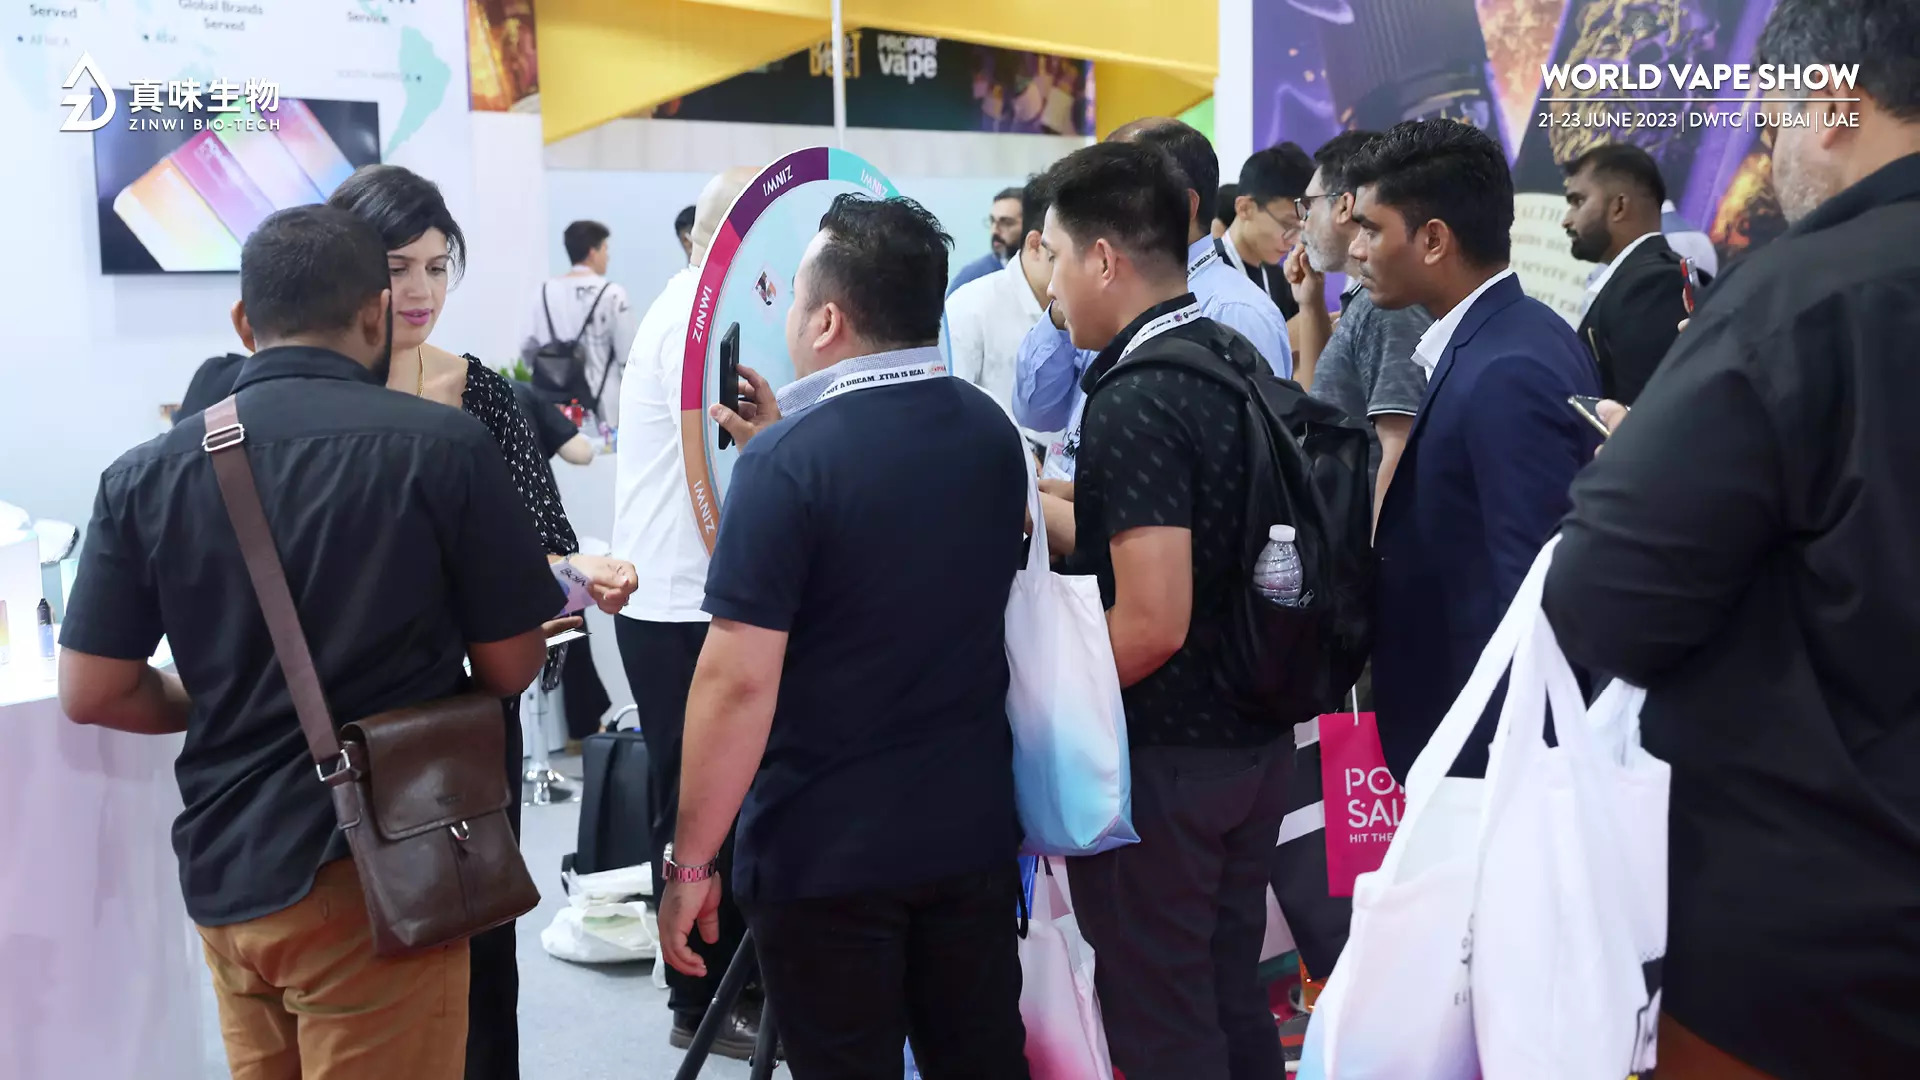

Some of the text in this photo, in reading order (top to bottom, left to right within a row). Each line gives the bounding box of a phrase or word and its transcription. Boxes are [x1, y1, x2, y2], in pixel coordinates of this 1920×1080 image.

[29, 4, 78, 19] Served
[222, 1, 264, 15] Brands
[203, 18, 246, 32] Served
[877, 33, 938, 54] PROPER
[878, 53, 938, 84] vape
[763, 164, 794, 197] ZINWI
[860, 168, 889, 199] ZINWI
[692, 285, 713, 344] ZINWI
[846, 375, 875, 386] DREAM
[879, 371, 900, 381] XTRA
[909, 368, 925, 377] REAL
[693, 479, 715, 535] ZINWI
[1347, 798, 1407, 828] SAL
[1349, 833, 1368, 843] HIT
